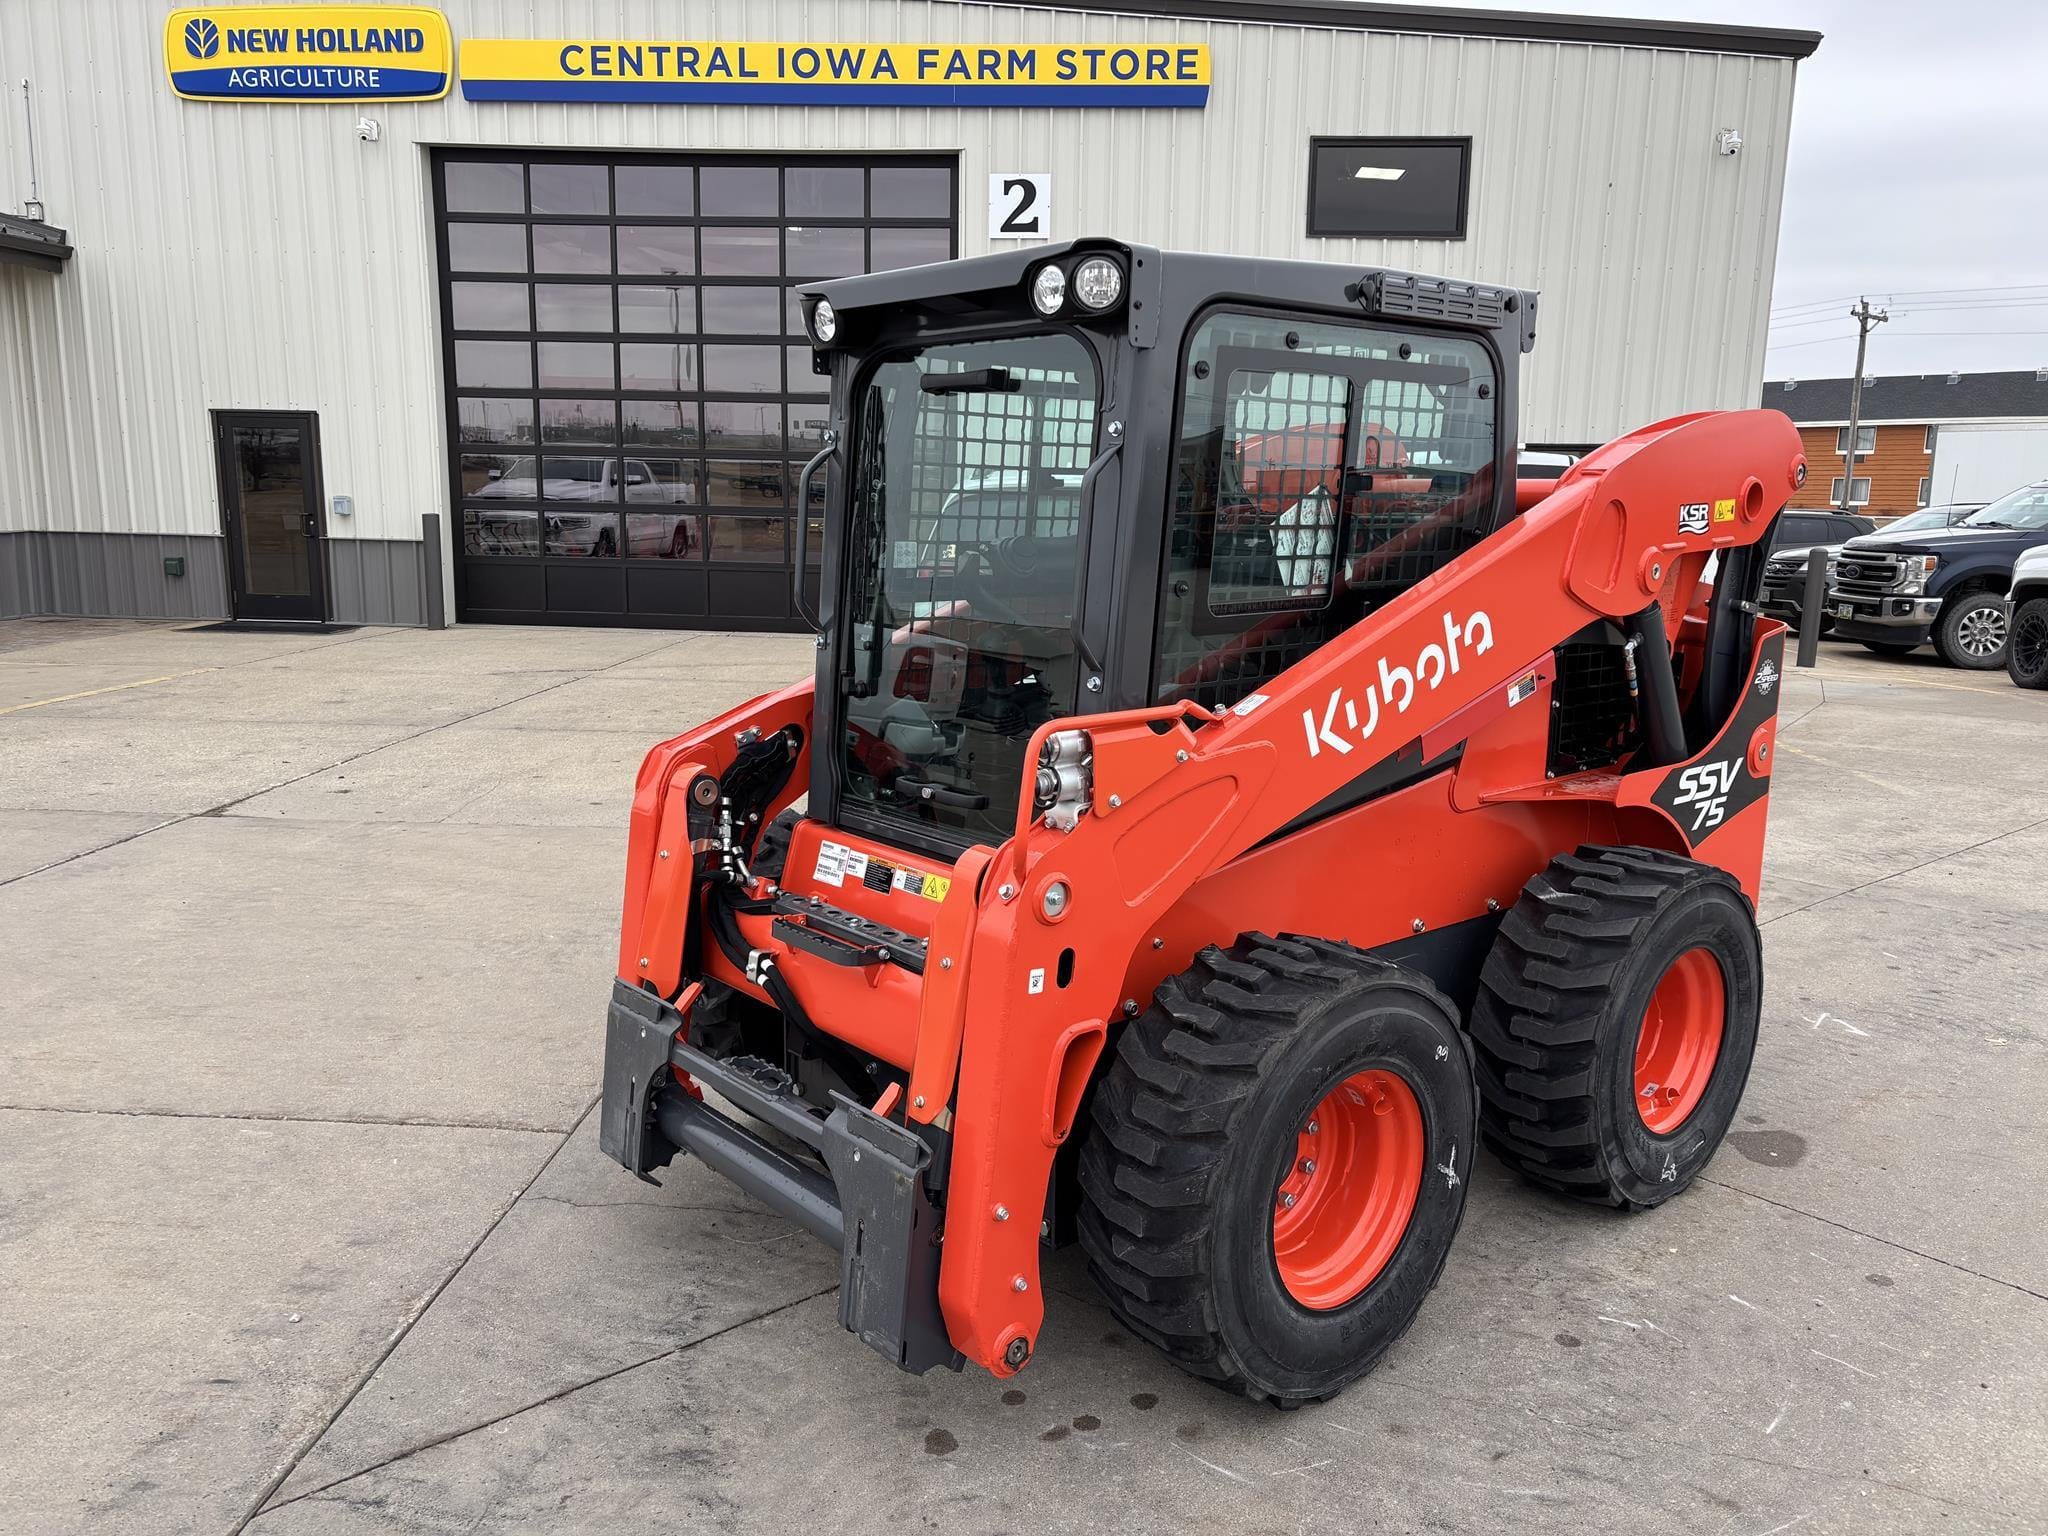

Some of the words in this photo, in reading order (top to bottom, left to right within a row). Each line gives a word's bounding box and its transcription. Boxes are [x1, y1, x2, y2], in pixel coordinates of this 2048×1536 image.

[227, 29, 289, 53] NEW
[296, 28, 424, 53] HOLLAND
[228, 69, 380, 88] AGRICULTURE
[560, 45, 759, 78] CENTRAL
[778, 48, 899, 80] IOWA
[918, 49, 1036, 80] FARM
[1056, 49, 1198, 80] STORE
[1000, 178, 1039, 233] 2
[1679, 503, 1709, 521] KSR
[1303, 610, 1494, 758] Kubota
[1673, 757, 1744, 805] SSV
[1691, 795, 1728, 831] 75
